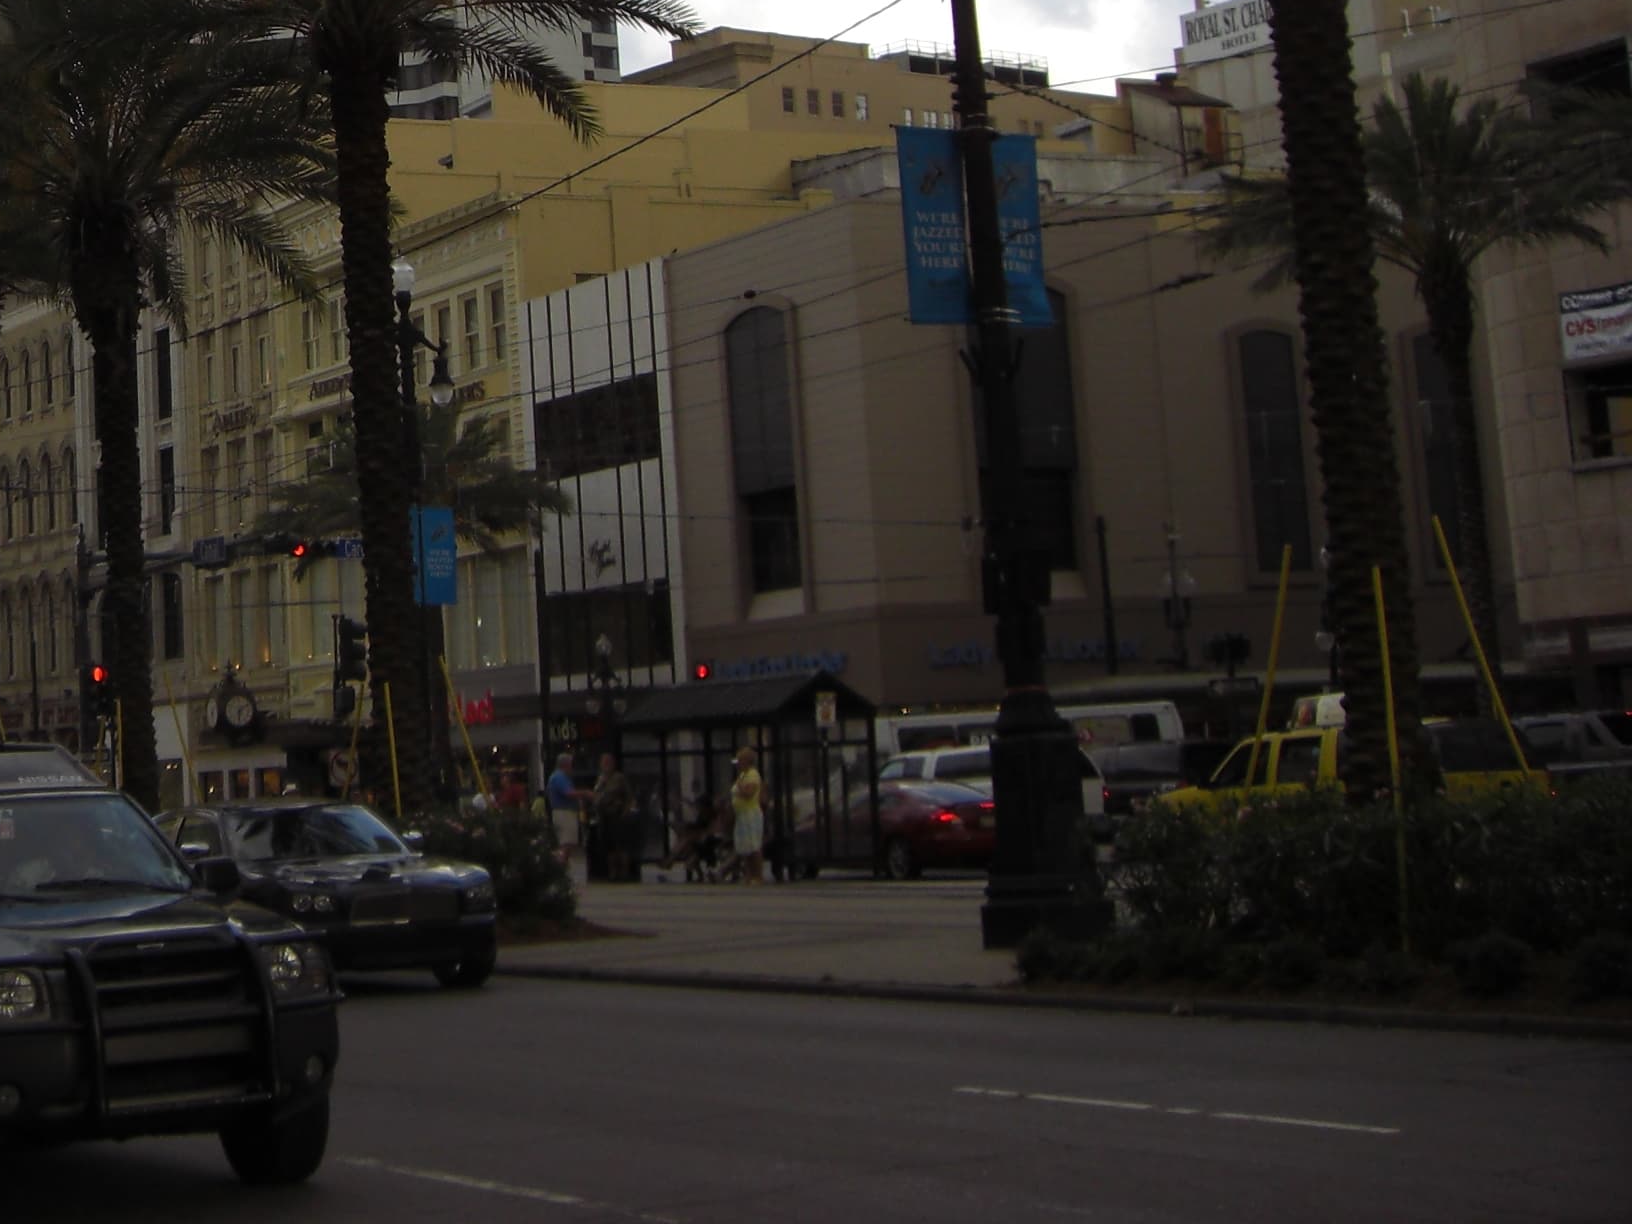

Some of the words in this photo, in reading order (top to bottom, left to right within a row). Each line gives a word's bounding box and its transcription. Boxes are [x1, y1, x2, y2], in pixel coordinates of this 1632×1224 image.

[1184, 12, 1221, 45] ROYAL
[1241, 0, 1273, 29] CHAR
[1221, 32, 1256, 49] HOTEL
[1566, 317, 1596, 337] CVS
[344, 540, 366, 558] Can
